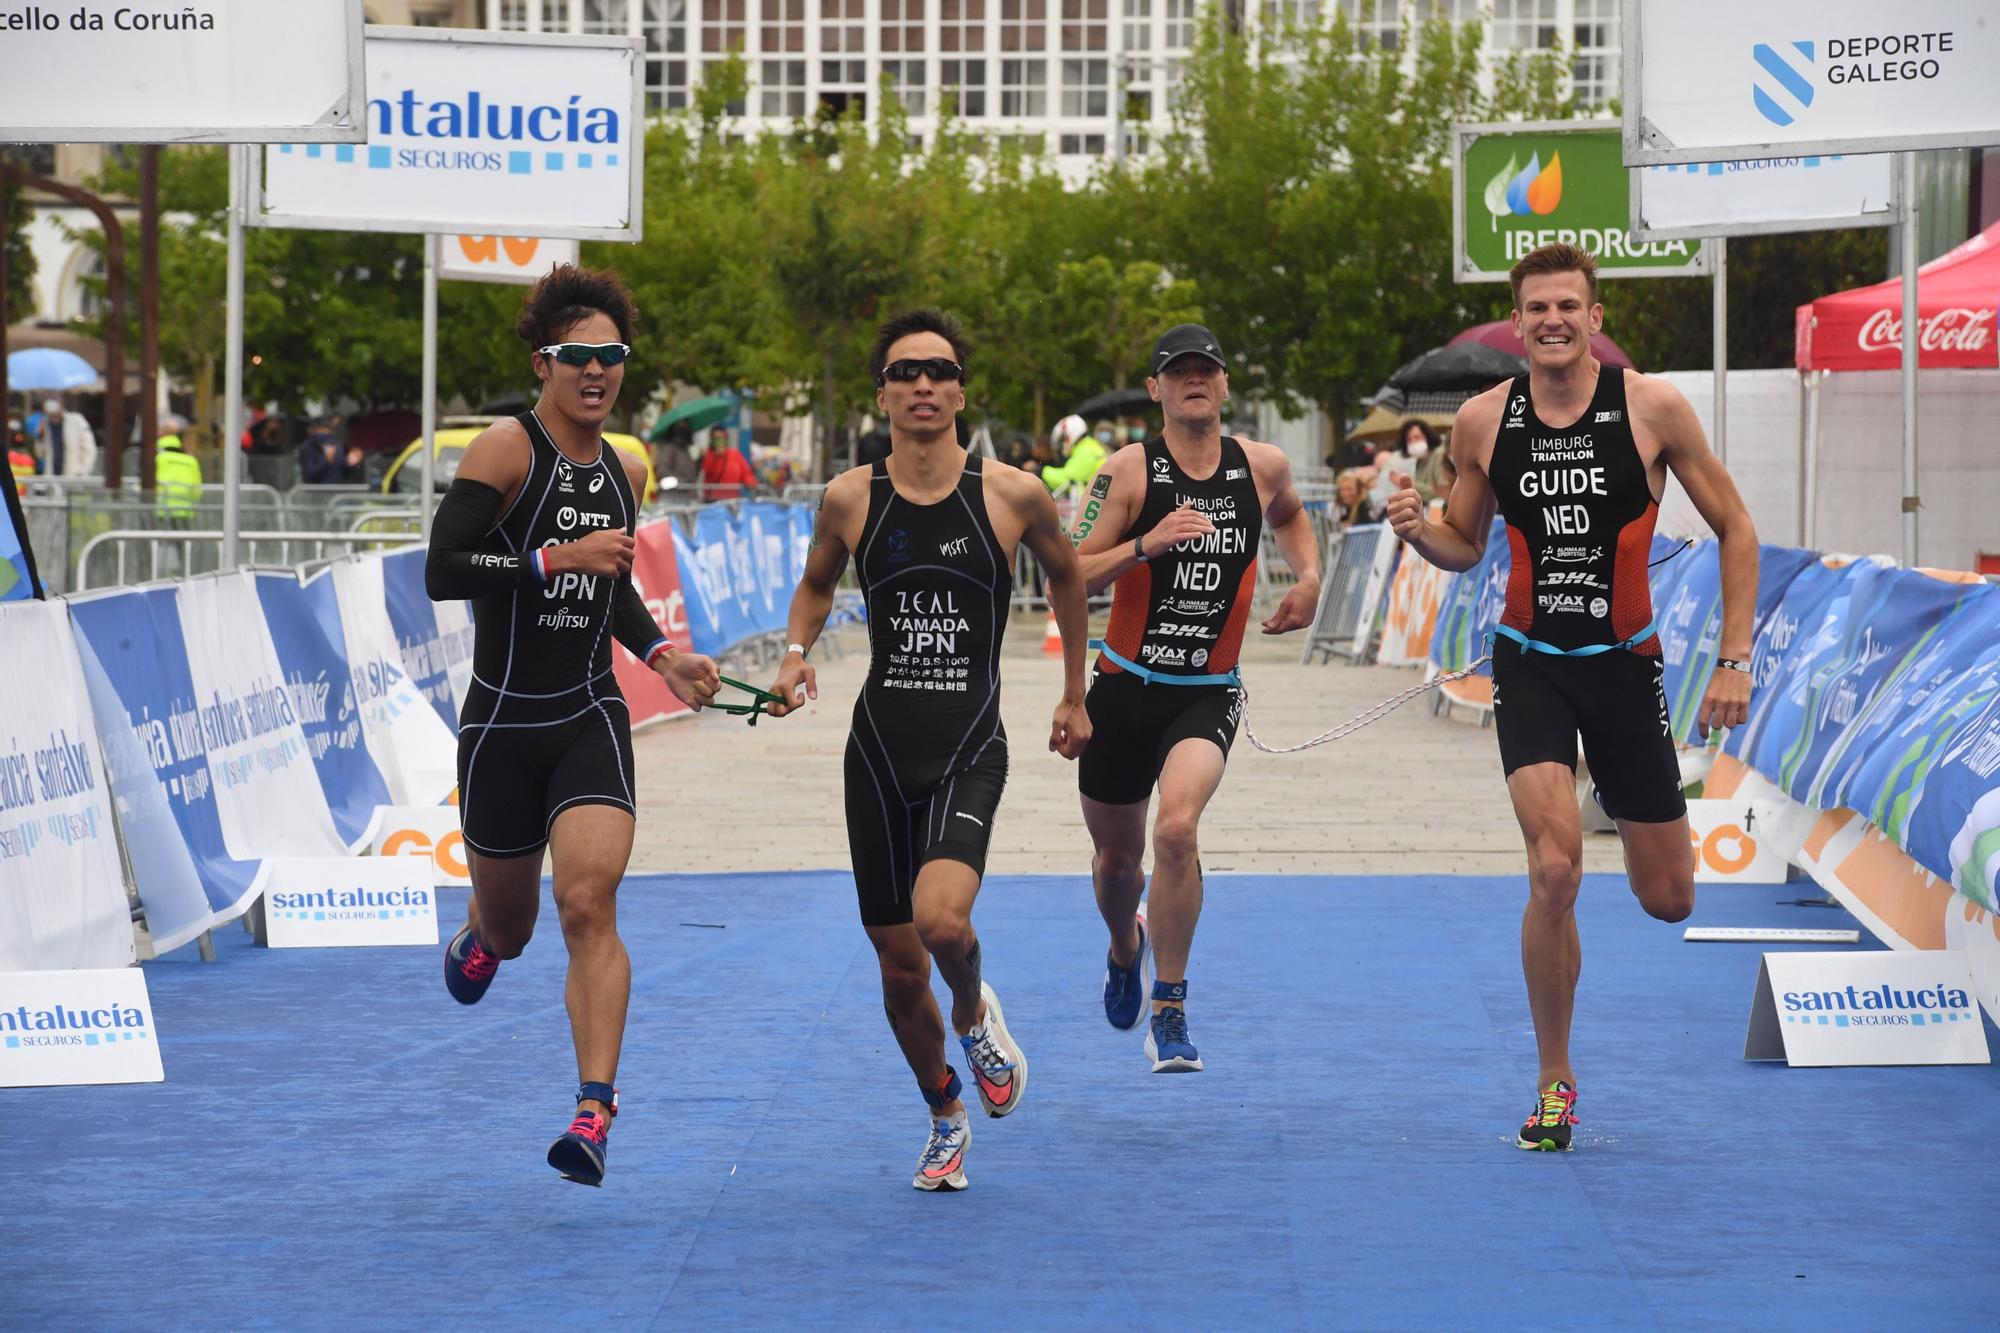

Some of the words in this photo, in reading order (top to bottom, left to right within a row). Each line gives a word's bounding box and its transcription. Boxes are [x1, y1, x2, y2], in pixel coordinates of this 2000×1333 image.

[69, 7, 104, 30] da
[113, 6, 214, 31] Coruña
[1828, 32, 1954, 59] DEPORTE
[1827, 59, 1940, 85] GALEGO
[398, 148, 503, 172] SEGUROS
[1531, 434, 1593, 451] LIMBURG
[1531, 449, 1594, 462] TRIATHLON
[1519, 466, 1608, 498] GUIDE
[580, 512, 611, 528] NTT
[1542, 504, 1590, 537] NED
[478, 555, 519, 568] reric
[543, 573, 597, 601] JPN
[1173, 562, 1221, 592] NED
[1547, 572, 1600, 587] DHL
[896, 590, 959, 615] ZEAL
[1538, 593, 1585, 614] RIXAX
[537, 607, 590, 631] FUJITSU
[889, 617, 970, 632] YAMADA
[1158, 622, 1211, 639] DHL
[899, 632, 956, 654] JPN
[1142, 643, 1188, 665] RIXAX
[272, 886, 429, 908] santalucía
[327, 911, 376, 920] SEGUROS
[1783, 984, 1970, 1011] santalucía
[1851, 1014, 1909, 1027] SEGUROS
[23, 1035, 82, 1047] SEGUROS
